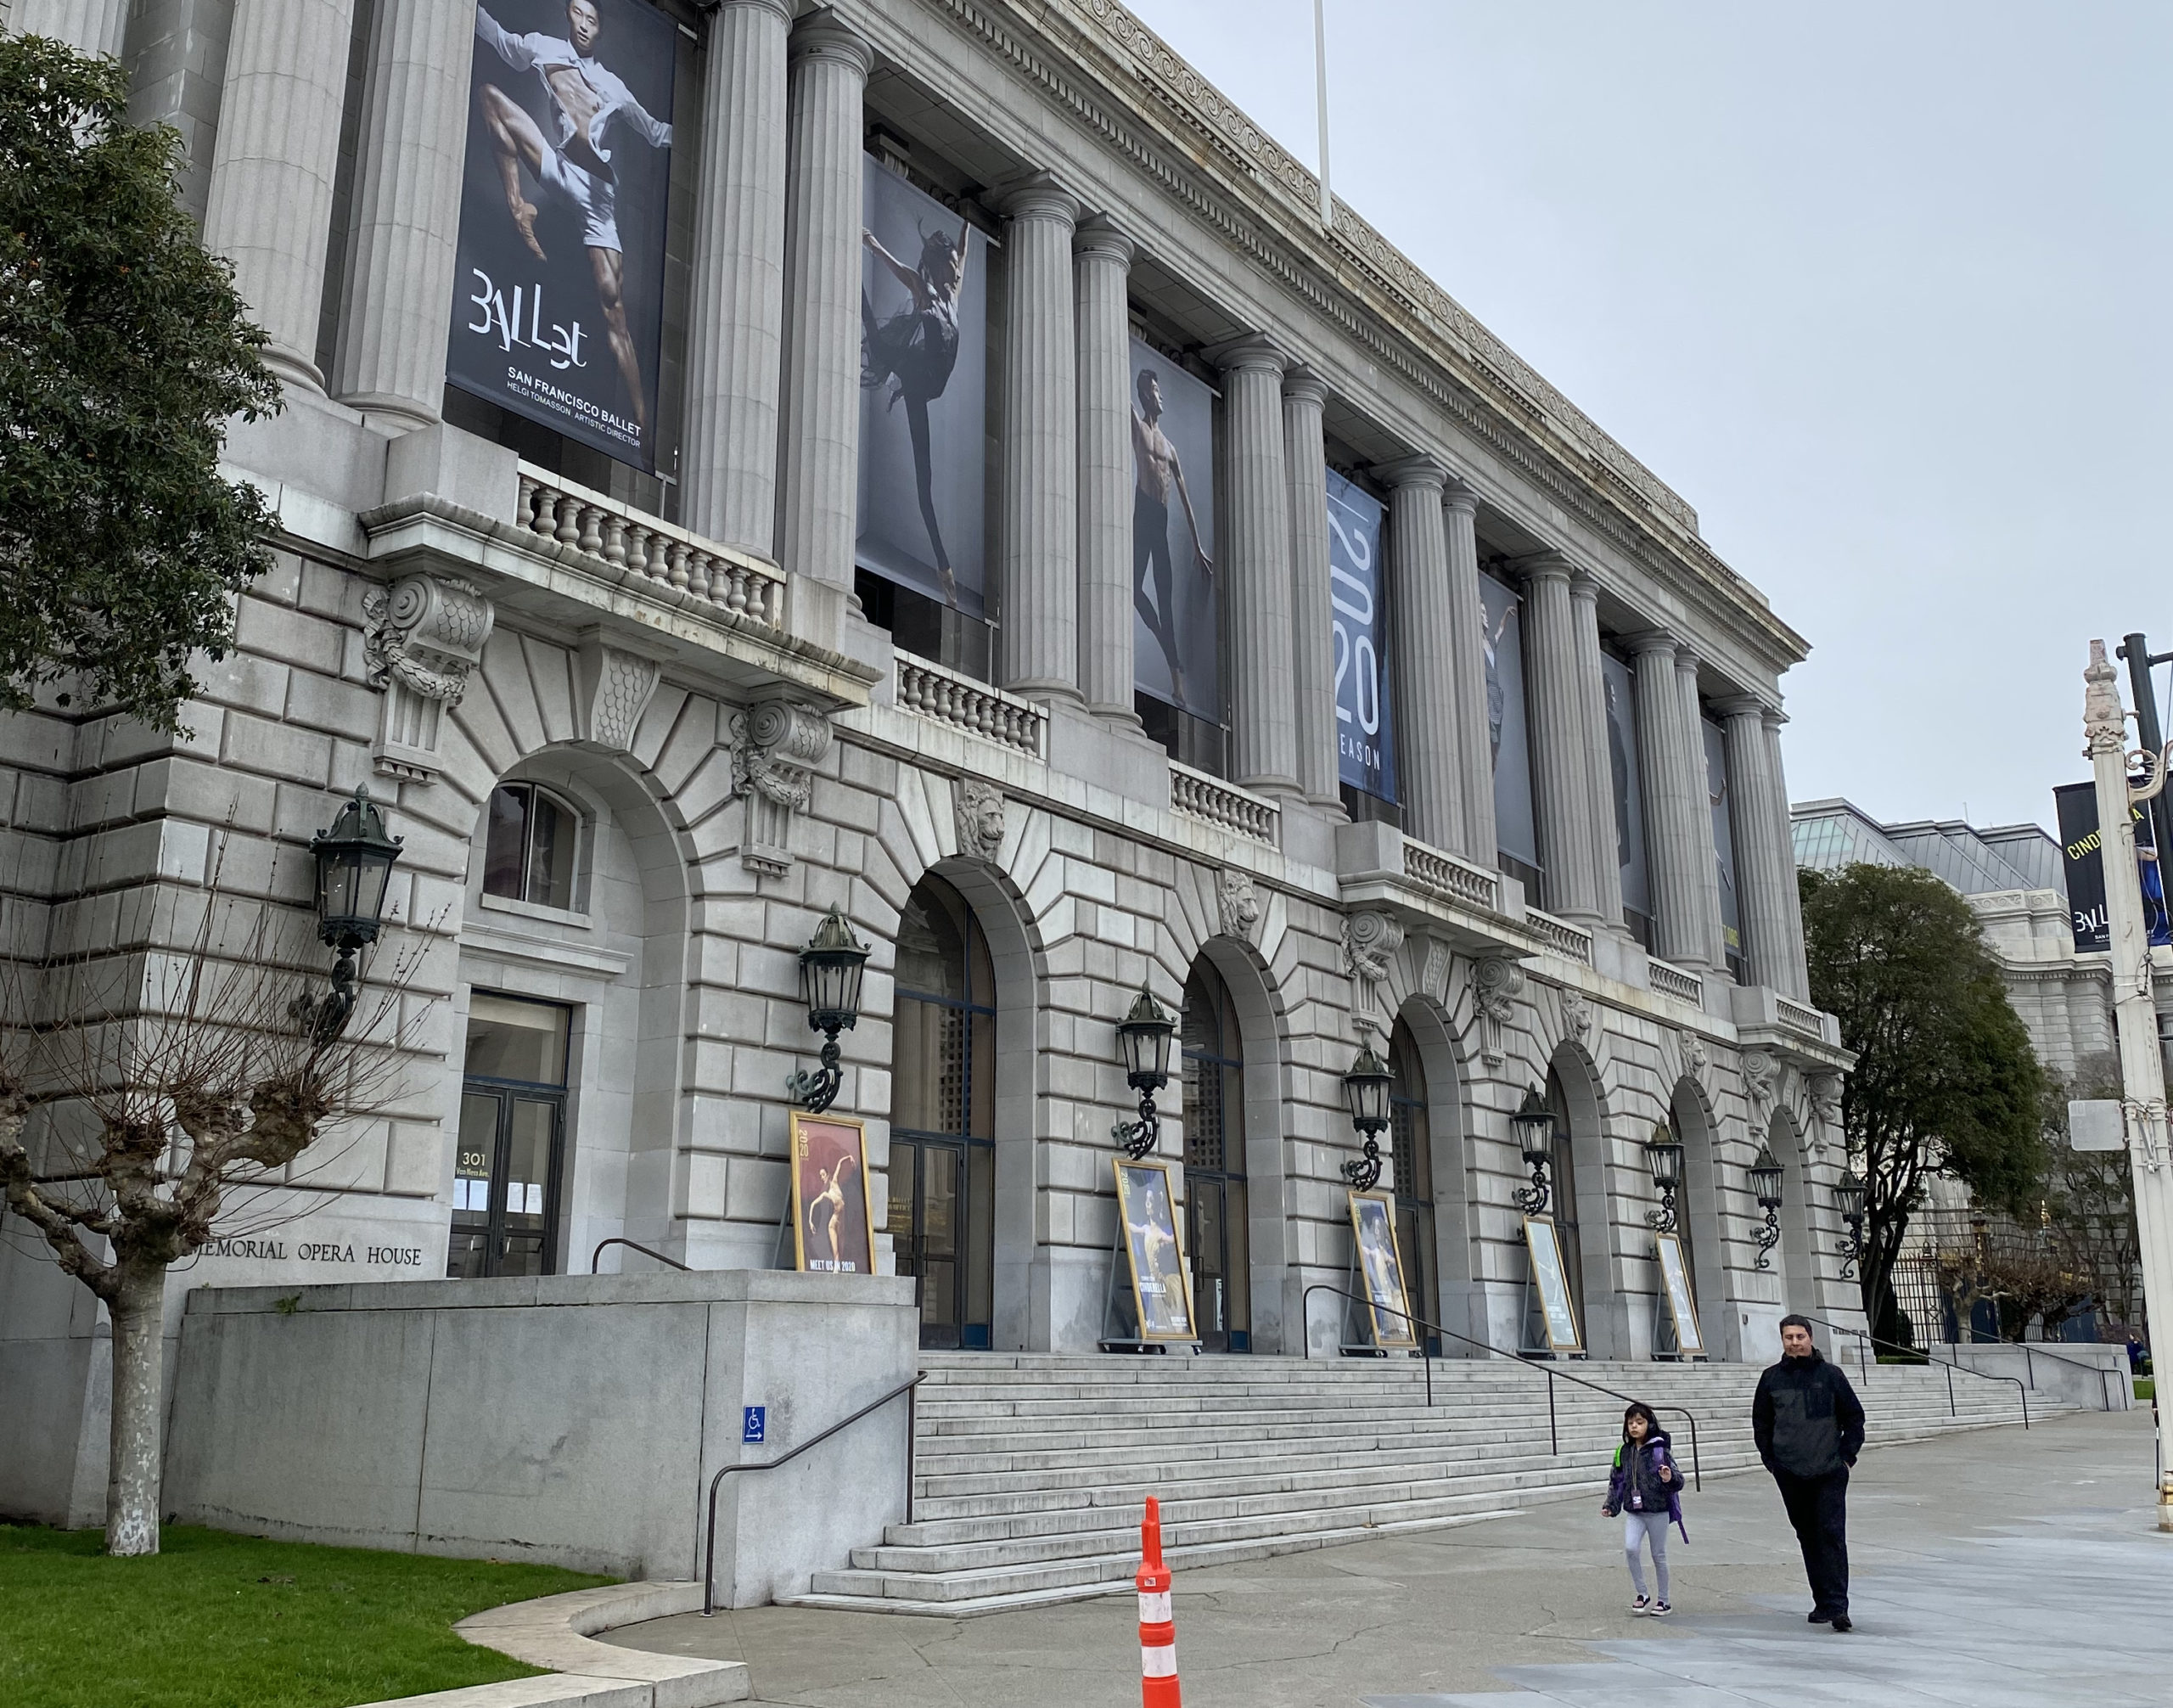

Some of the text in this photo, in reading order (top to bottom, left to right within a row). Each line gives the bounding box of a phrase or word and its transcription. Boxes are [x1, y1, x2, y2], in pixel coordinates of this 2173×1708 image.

[507, 381, 641, 448] HELGI TOMASSON ARTISTIC DIRECTOR
[508, 367, 642, 436] SAN FRANCISCO BALLET
[1340, 733, 1380, 771] EASON
[2075, 904, 2109, 932] BALL
[463, 1152, 486, 1166] 301
[298, 1243, 356, 1262] OPERA
[367, 1246, 422, 1266] HOUSE
[810, 1259, 825, 1271] MEET
[825, 1260, 834, 1271] US
[841, 1261, 856, 1272] 2020
